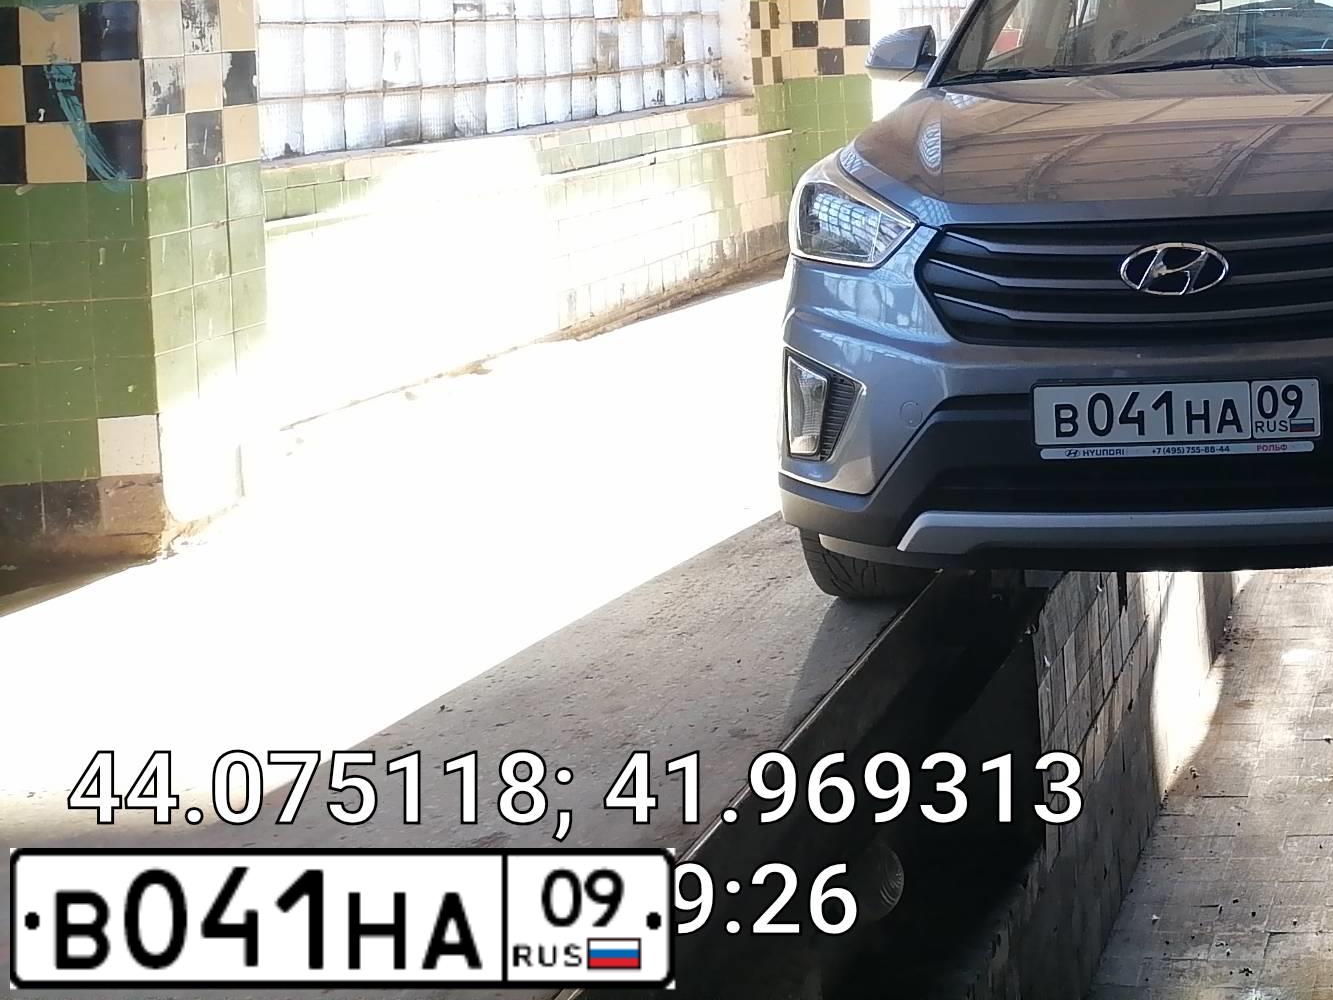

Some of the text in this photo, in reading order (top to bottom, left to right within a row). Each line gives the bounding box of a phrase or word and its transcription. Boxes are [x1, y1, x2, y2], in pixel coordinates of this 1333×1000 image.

[1257, 385, 1303, 419] 09
[1255, 419, 1289, 433] RUS
[1082, 448, 1125, 458] HYUNDAI
